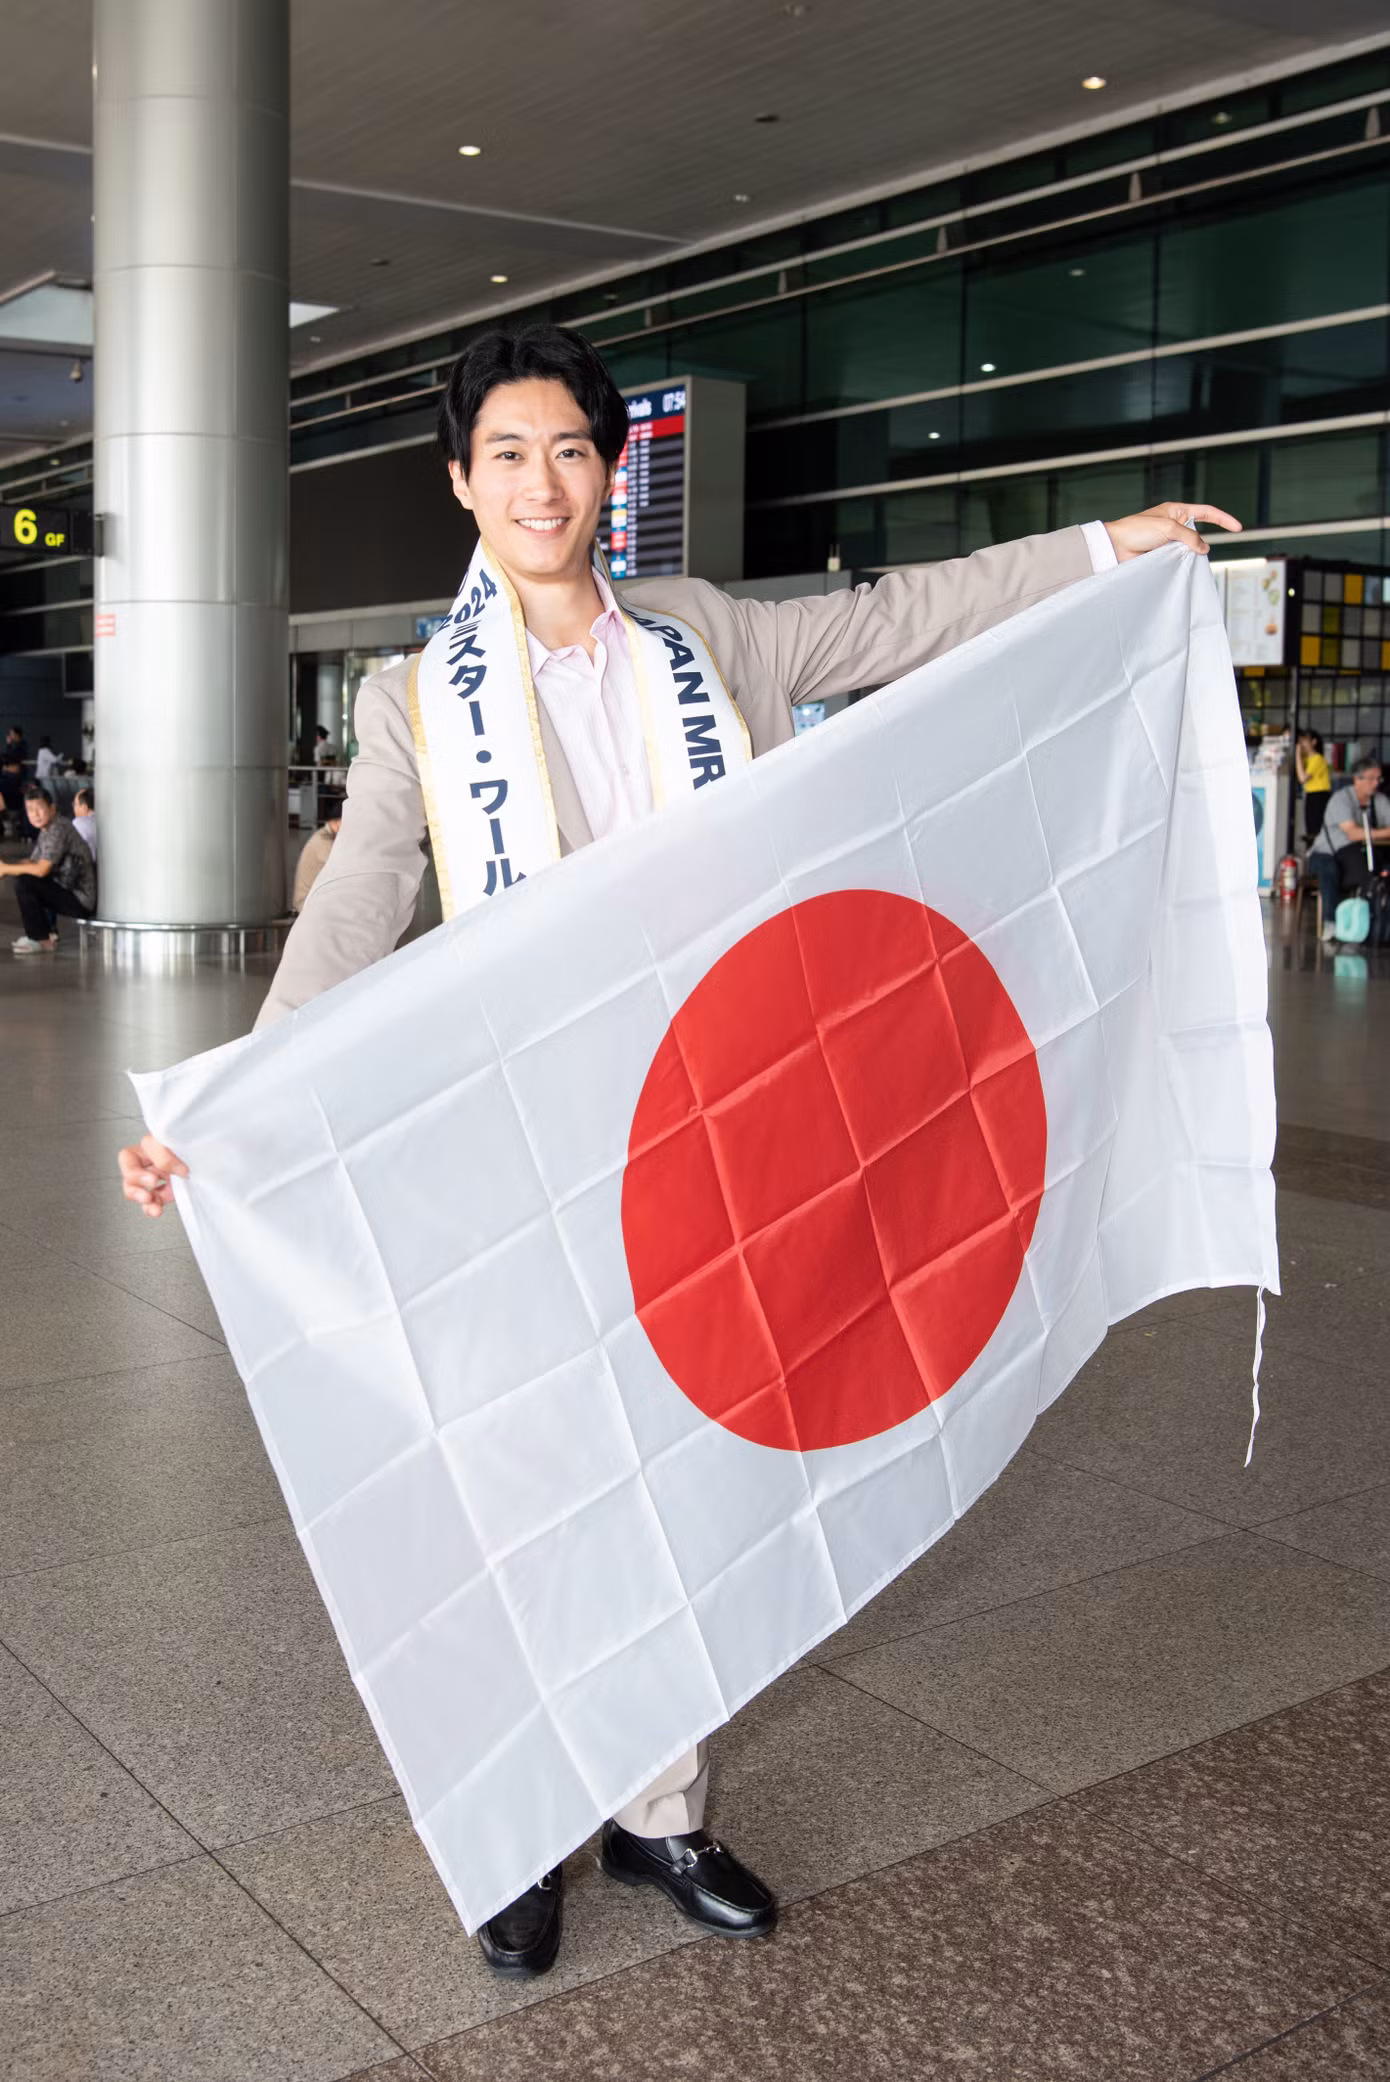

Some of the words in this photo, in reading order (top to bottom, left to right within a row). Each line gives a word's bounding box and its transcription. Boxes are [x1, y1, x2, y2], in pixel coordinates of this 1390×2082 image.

[13, 508, 38, 545] 6
[435, 568, 497, 634] 2024
[682, 714, 726, 790] MR
